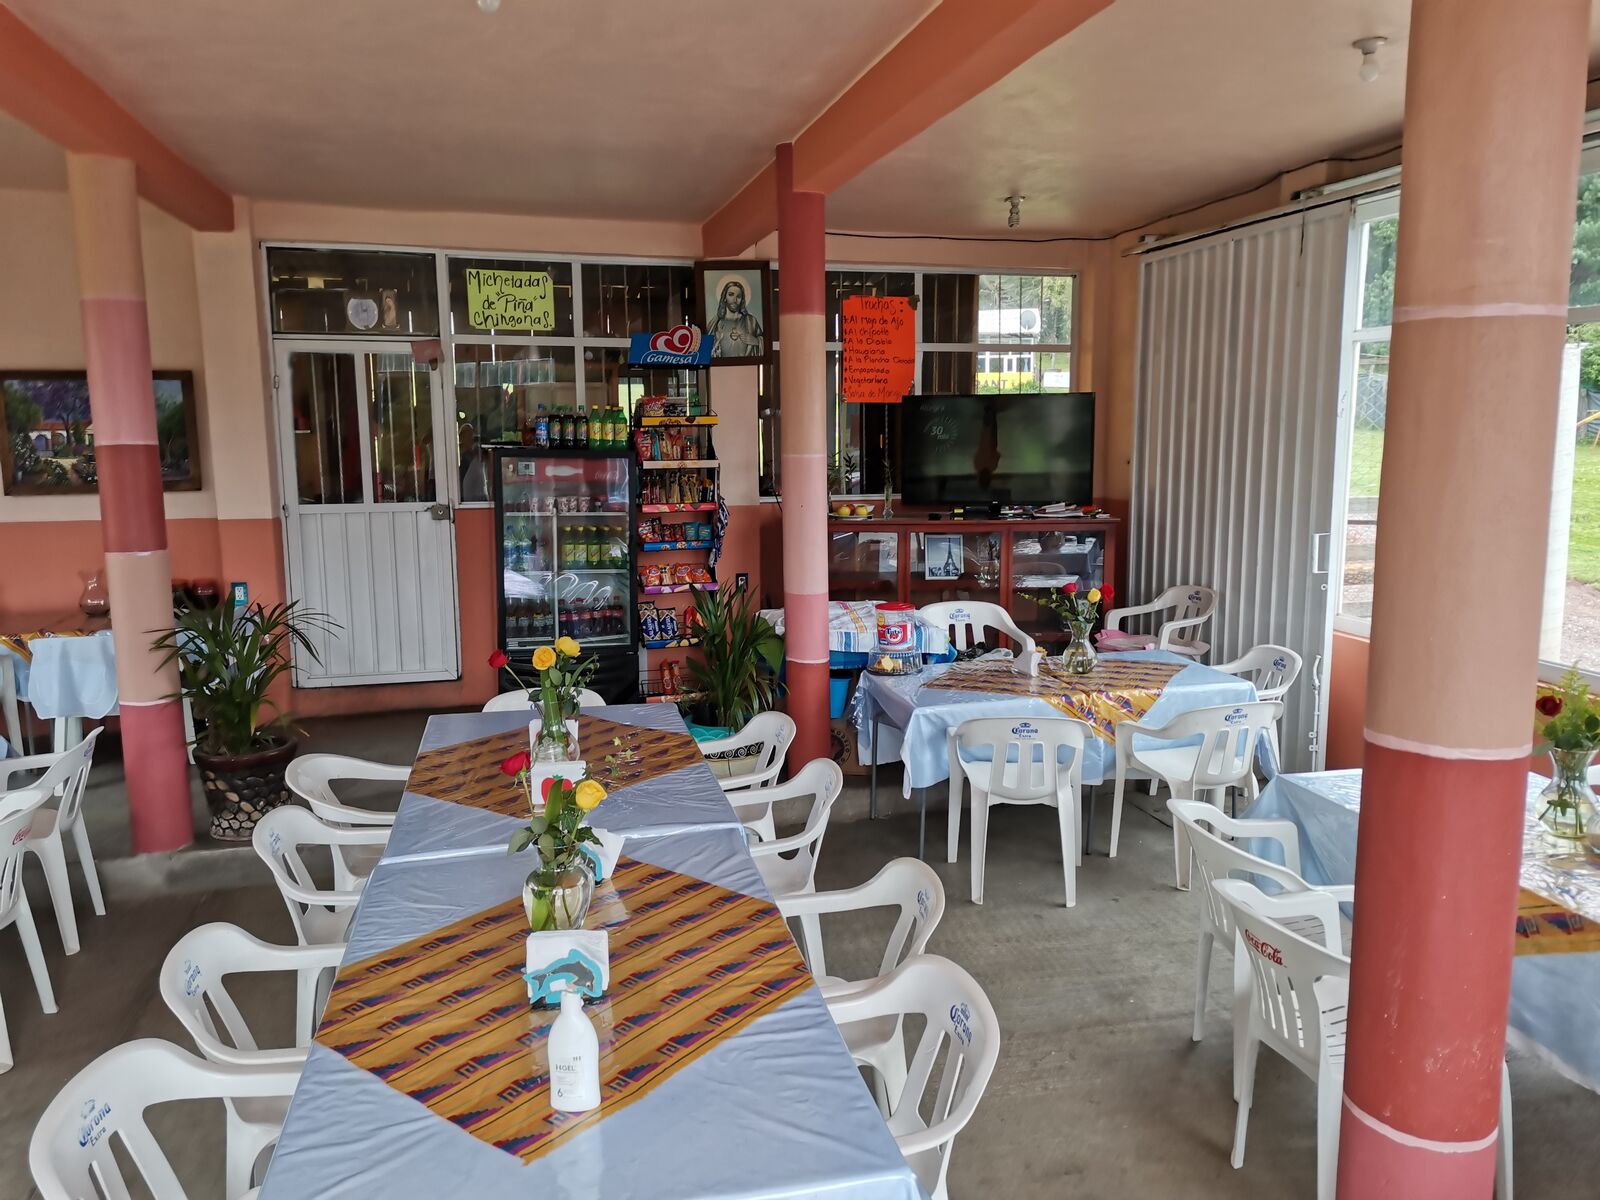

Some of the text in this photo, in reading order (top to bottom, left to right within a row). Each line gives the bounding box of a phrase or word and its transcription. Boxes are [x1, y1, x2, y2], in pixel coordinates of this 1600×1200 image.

[468, 270, 548, 299] Micheladas
[482, 295, 497, 310] de
[646, 353, 693, 365] Gamesa
[1011, 726, 1038, 735] Corona
[557, 1088, 564, 1098] 6
[79, 1102, 112, 1147] Corona
